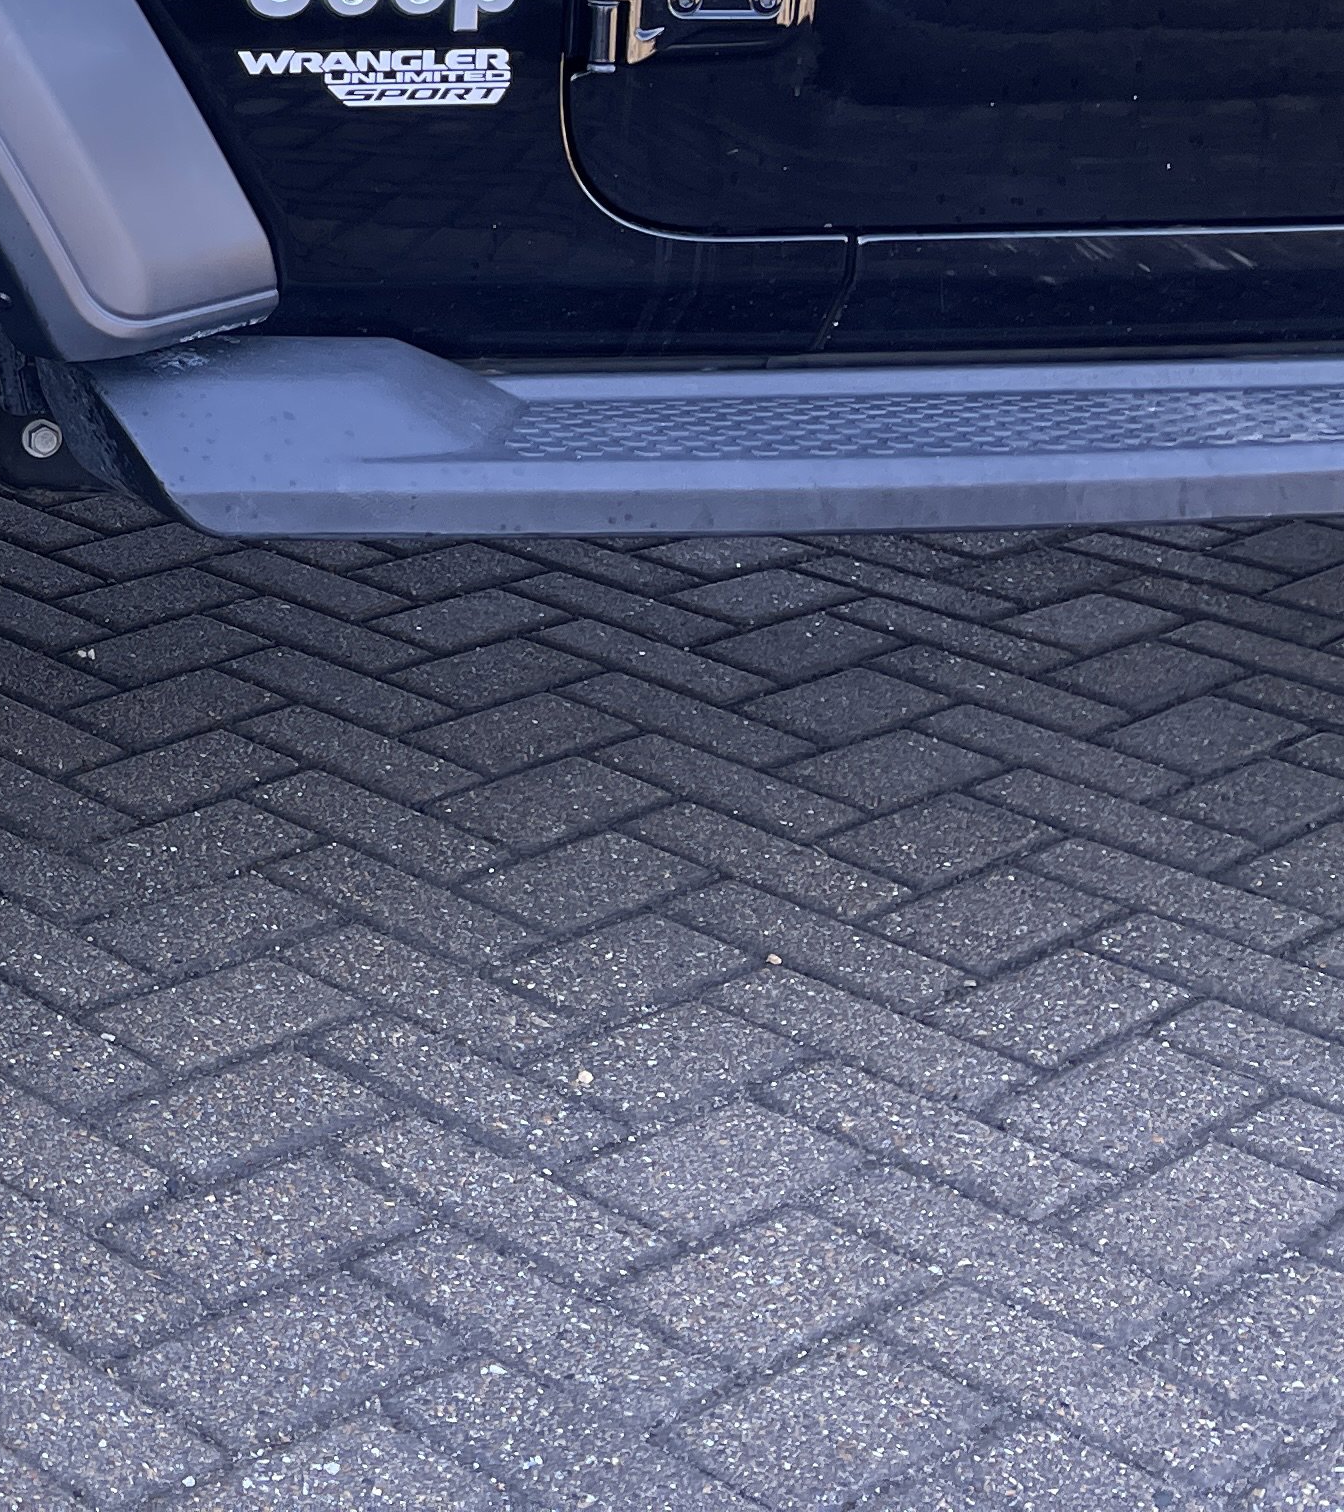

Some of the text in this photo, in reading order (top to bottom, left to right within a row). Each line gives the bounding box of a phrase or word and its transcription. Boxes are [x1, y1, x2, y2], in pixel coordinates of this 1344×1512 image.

[237, 48, 511, 75] WRANGLER
[323, 70, 512, 85] UNLIMITED
[344, 87, 501, 102] SPORT
